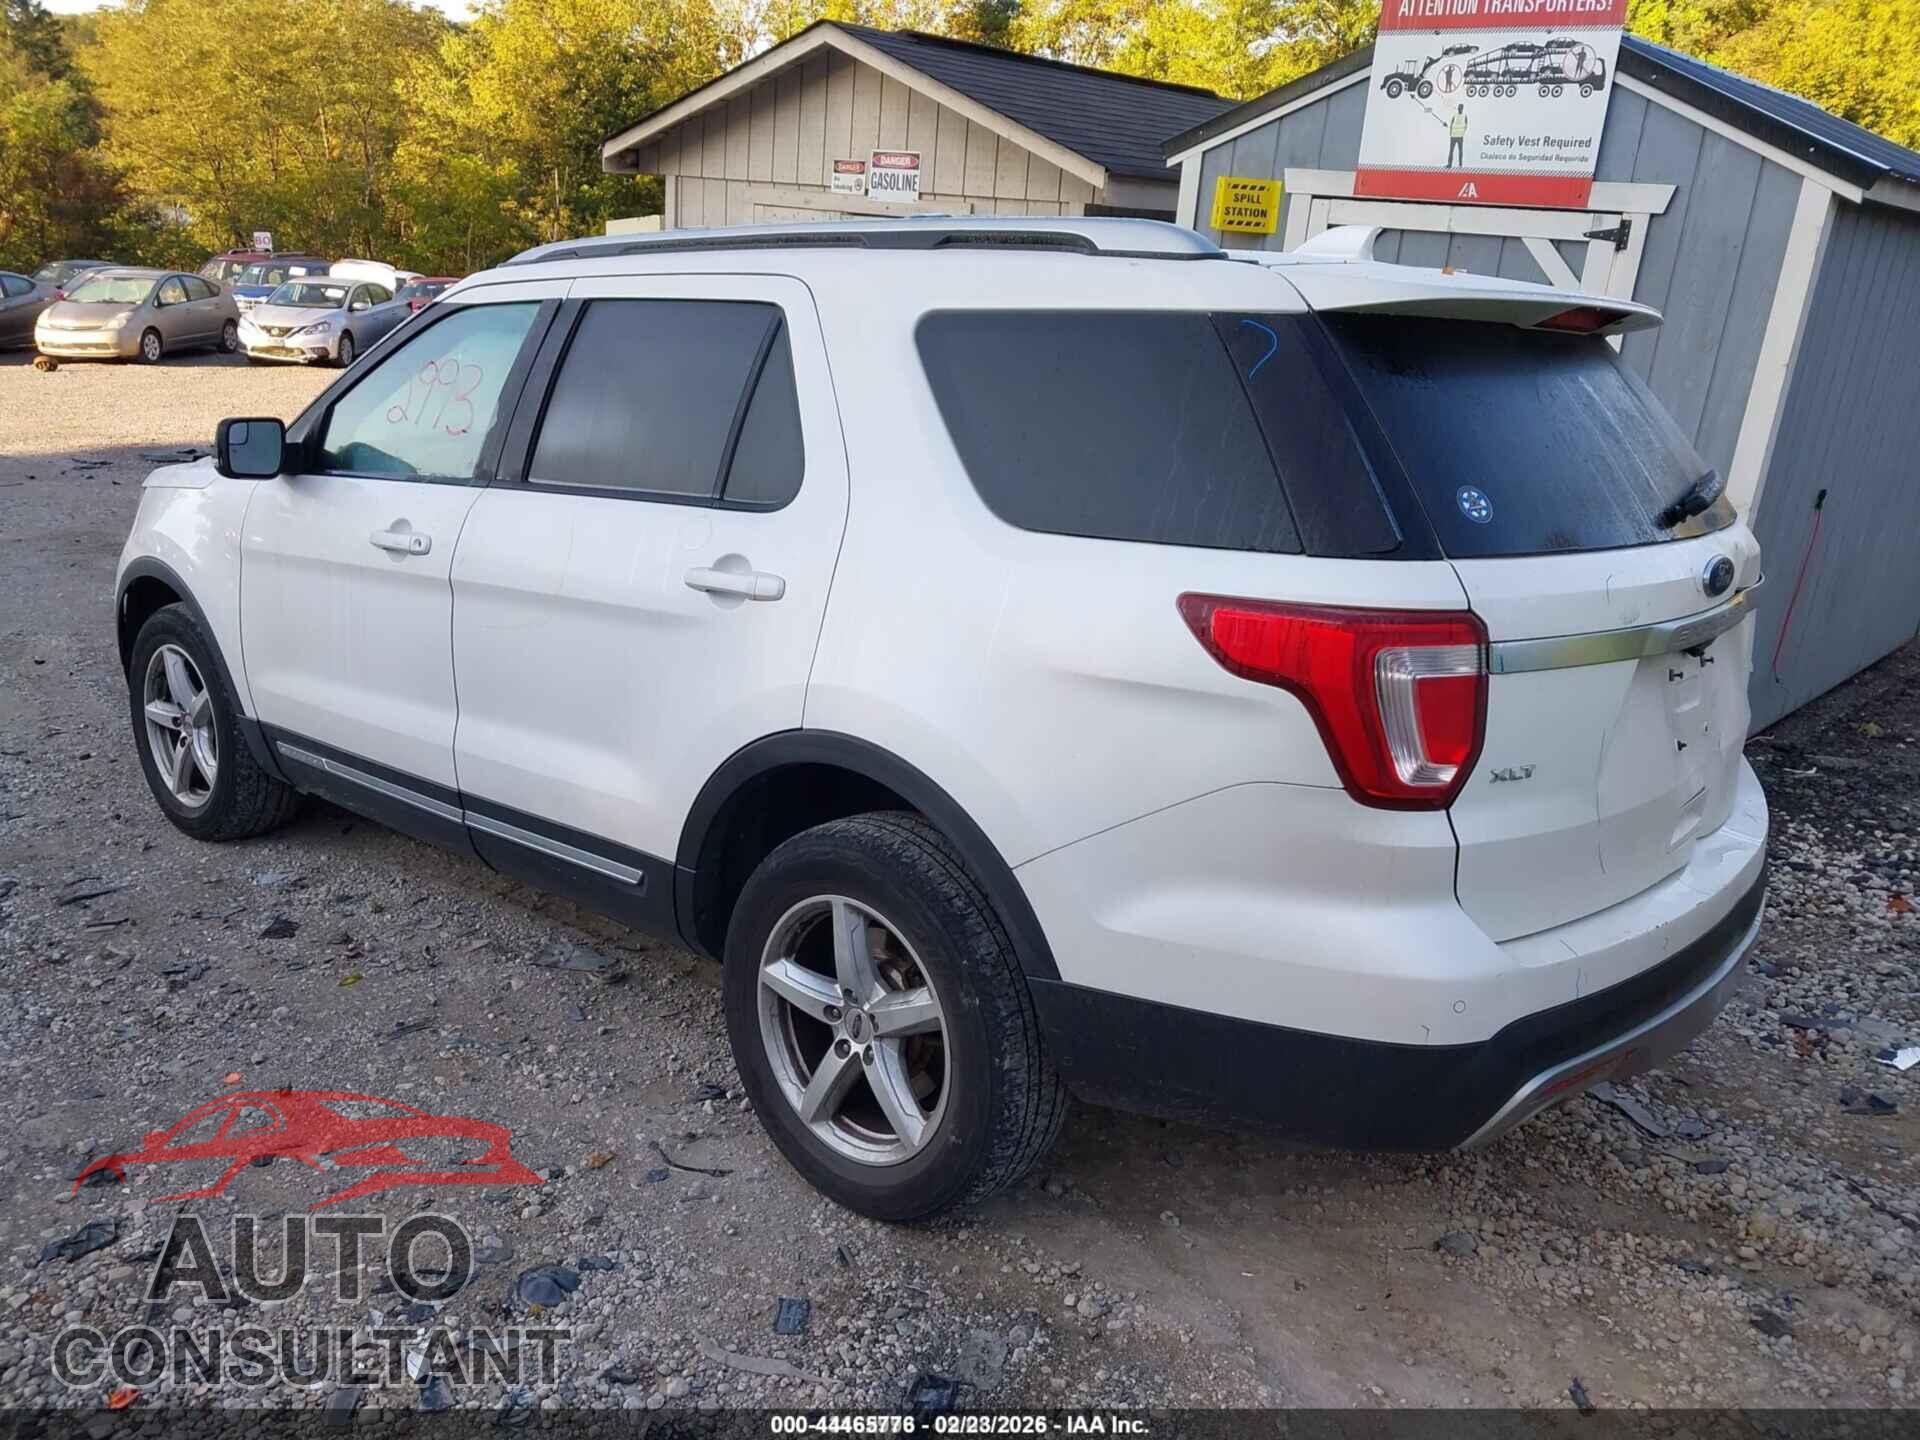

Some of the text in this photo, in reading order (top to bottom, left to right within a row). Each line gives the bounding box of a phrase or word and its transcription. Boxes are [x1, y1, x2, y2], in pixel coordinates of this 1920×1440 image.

[1398, 0, 1613, 16] ATTENTION TRANSPORTERS!
[1483, 134, 1593, 150] Safety Vest Required
[880, 155, 911, 168] DANGER
[1518, 152, 1554, 162] Seguridad
[871, 172, 918, 192] GASOLINE
[1233, 192, 1263, 204] SPILL
[1224, 206, 1268, 218] STATION
[1489, 764, 1536, 784] XLT
